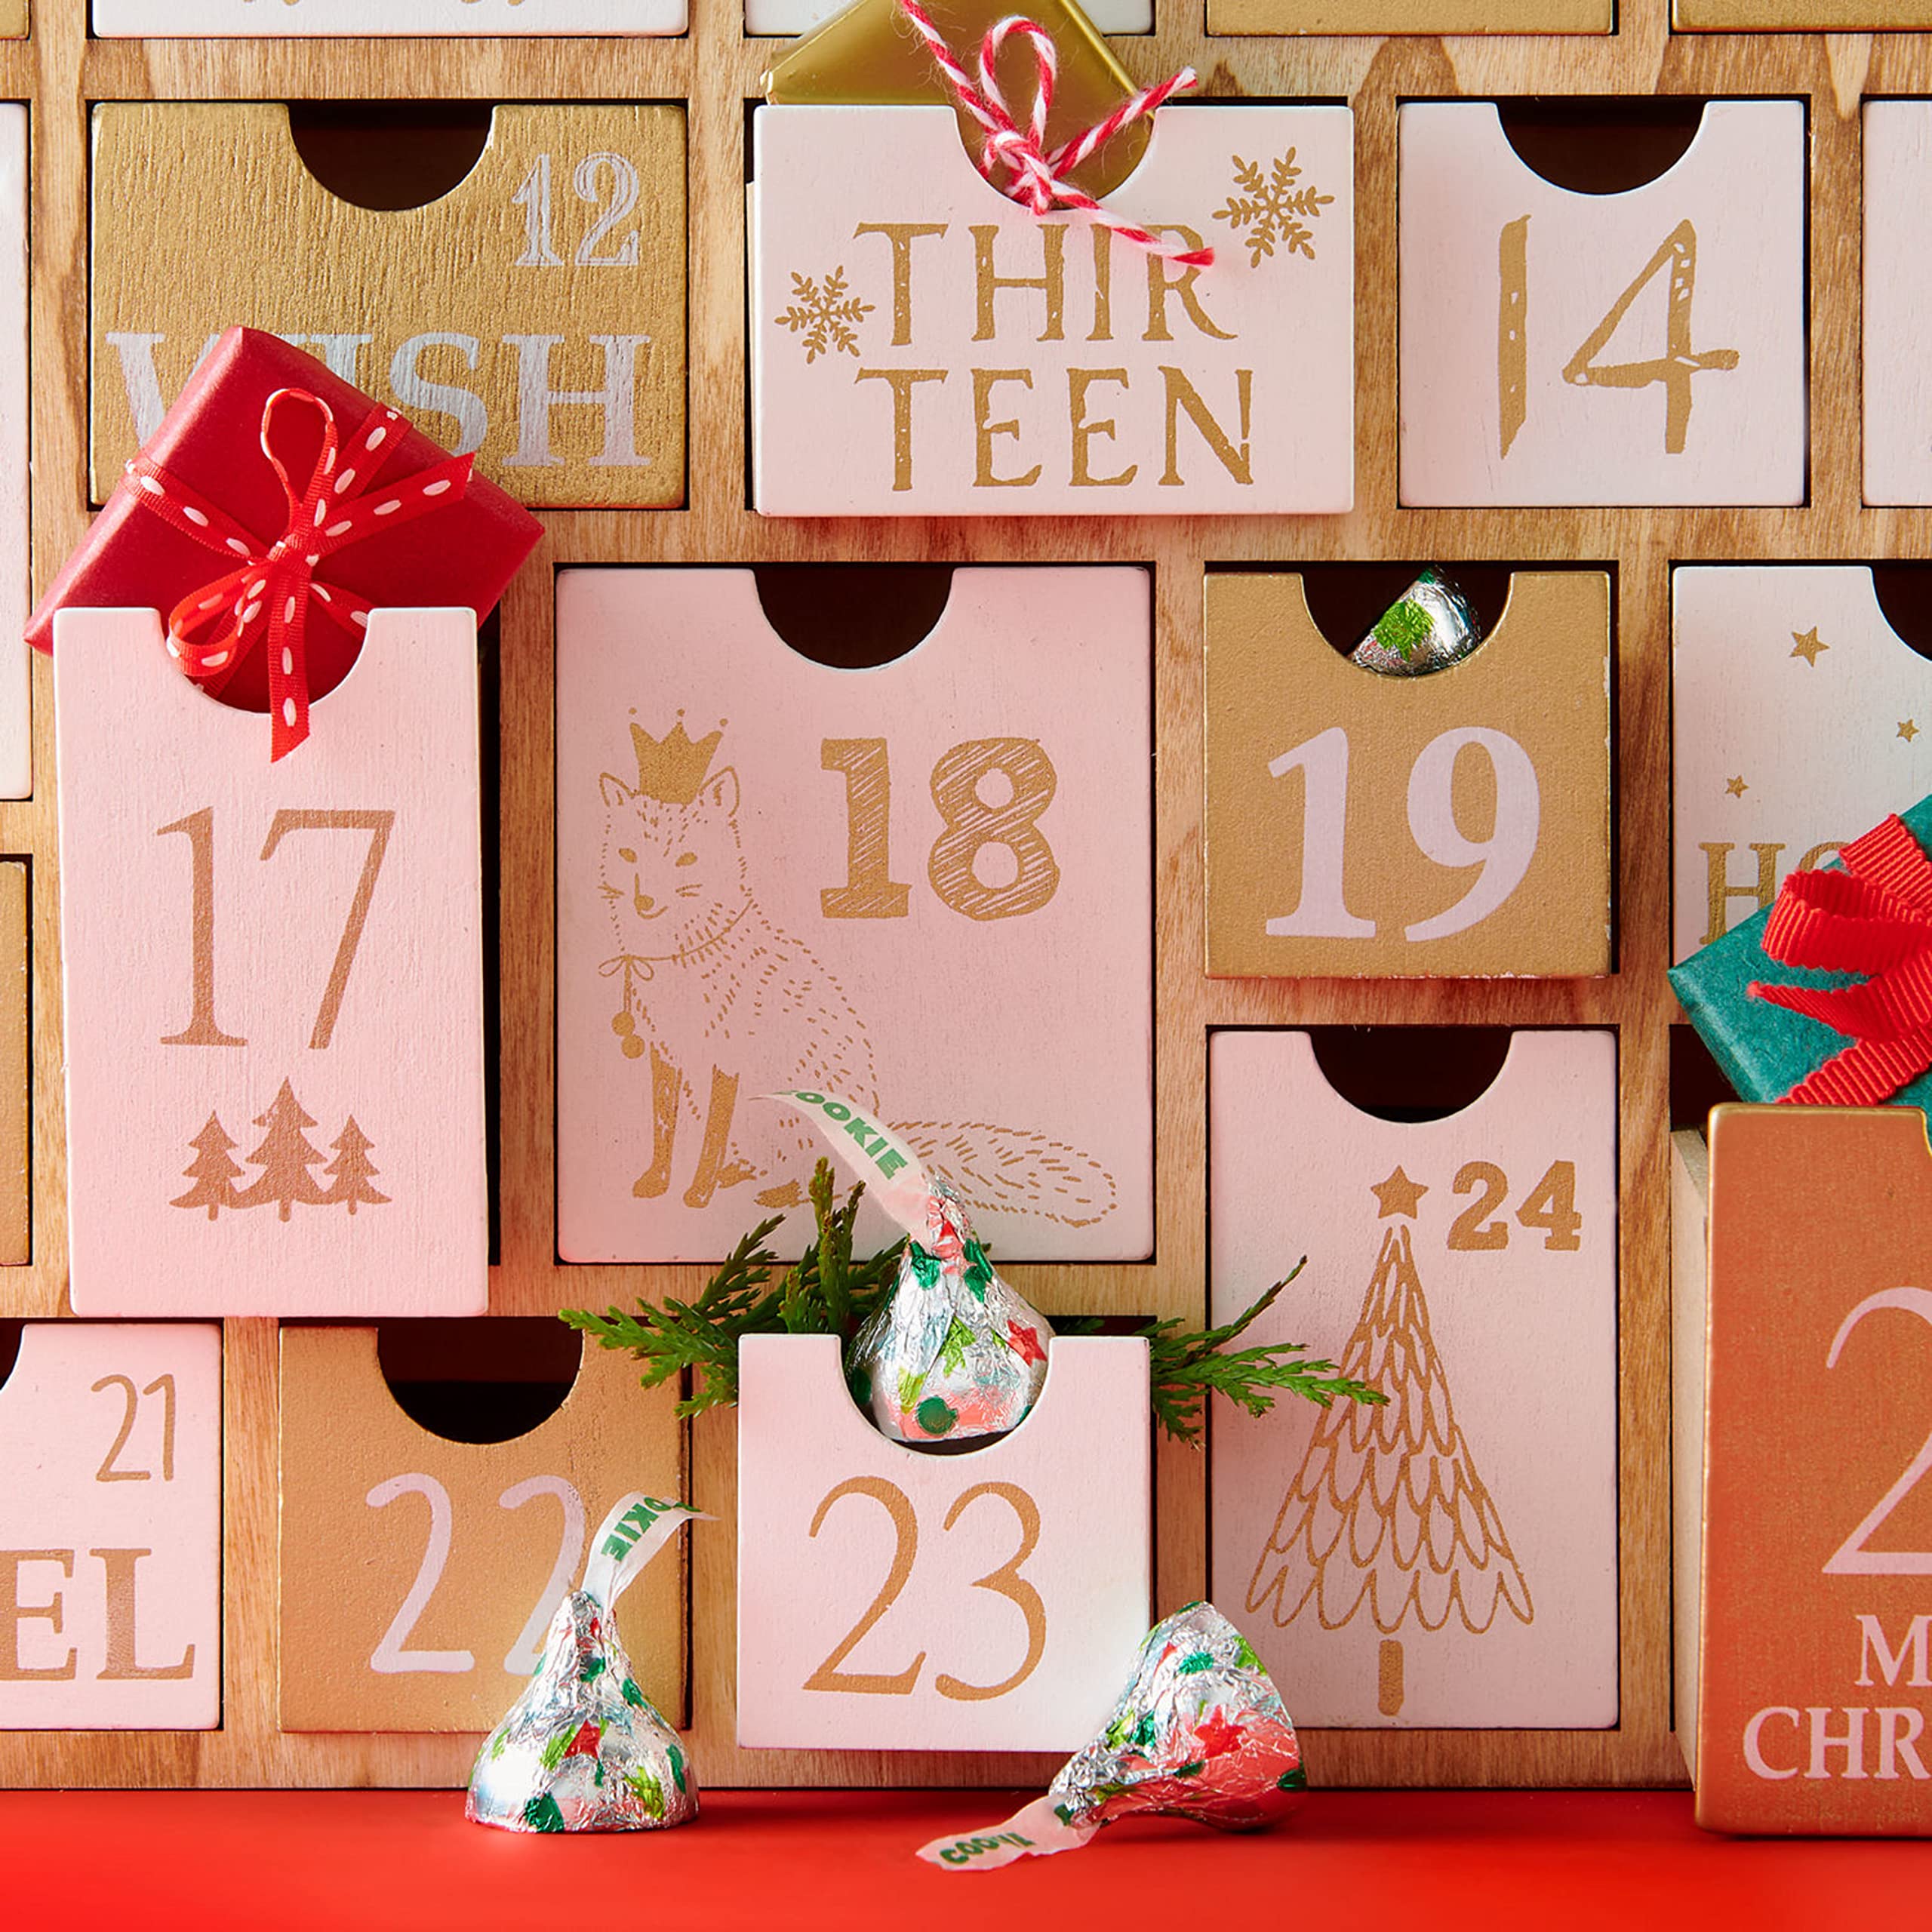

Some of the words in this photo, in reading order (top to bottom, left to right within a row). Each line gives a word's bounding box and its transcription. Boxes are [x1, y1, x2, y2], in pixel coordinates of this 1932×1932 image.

[512, 152, 640, 267] 12
[853, 222, 1238, 346] THIR
[1498, 215, 1740, 460] 14
[854, 365, 1254, 491] TEEN
[820, 737, 1061, 921] 18
[1266, 726, 1540, 943] 19
[1698, 841, 1849, 946] H
[156, 805, 396, 1050] 17
[771, 1090, 909, 1180] OOKIE
[1446, 1159, 1583, 1252] 24
[91, 1374, 176, 1483] 21
[0, 1548, 195, 1681] EL
[366, 1472, 586, 1676] 22
[801, 1475, 1048, 1702] 23
